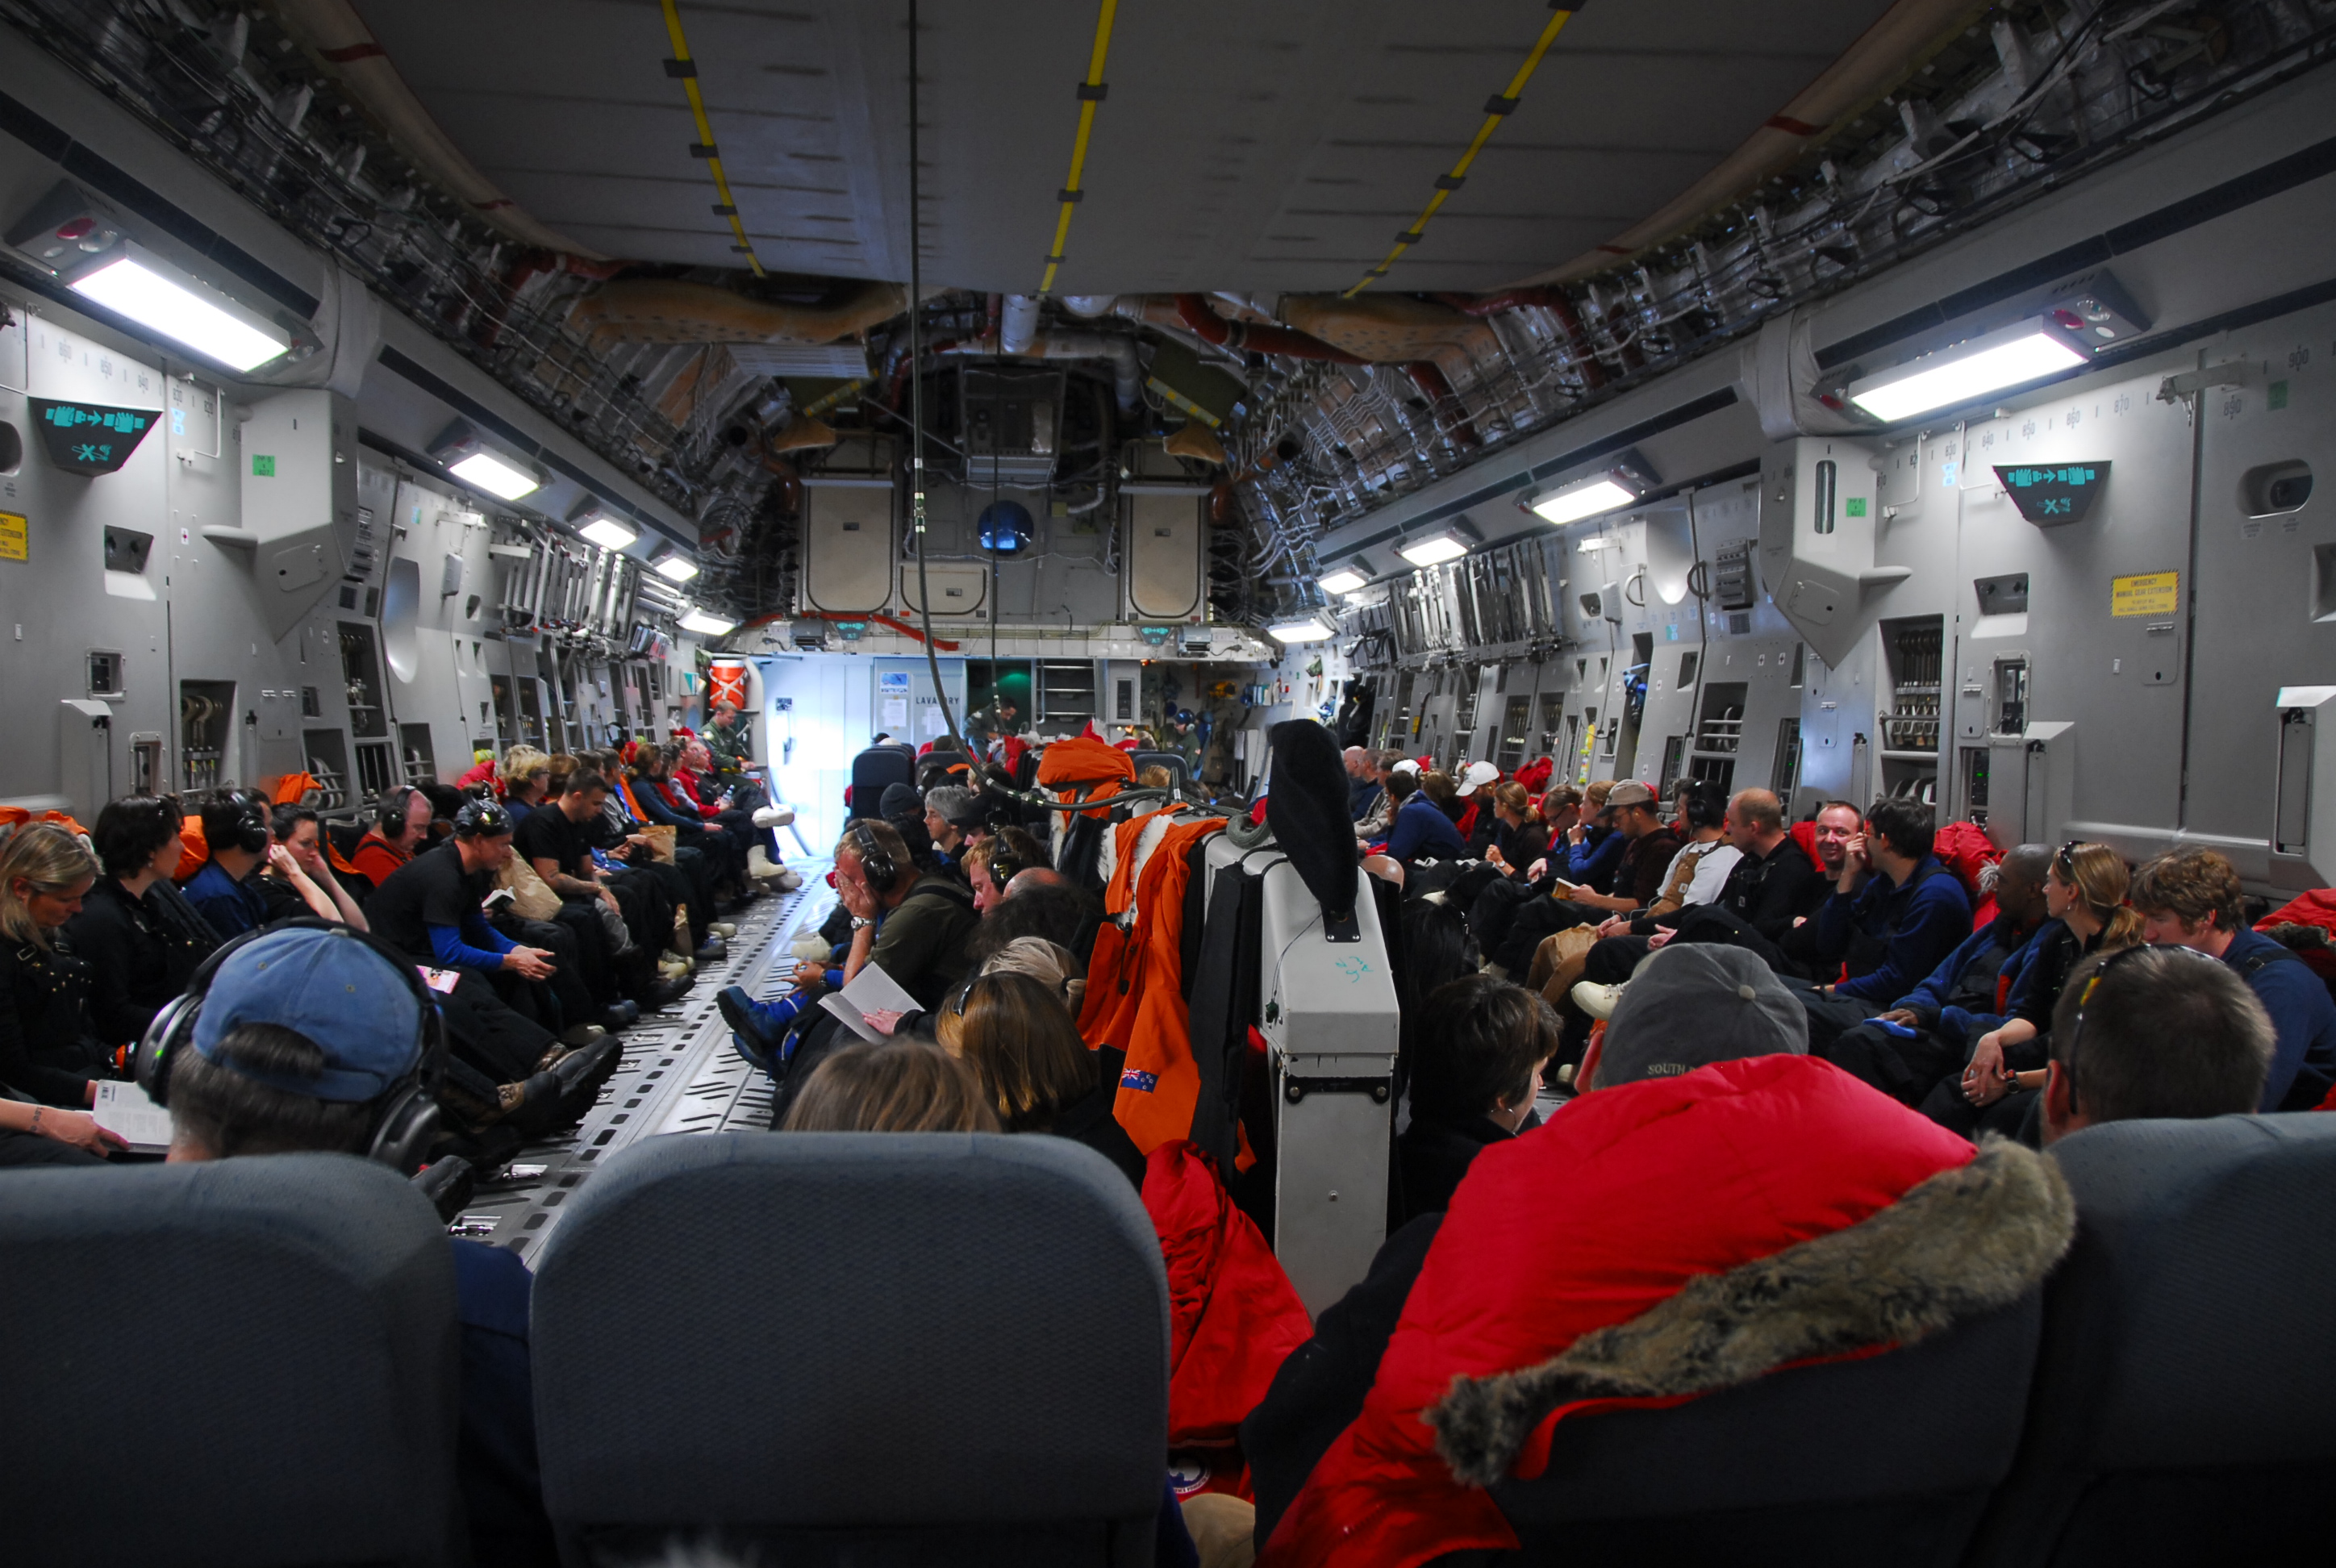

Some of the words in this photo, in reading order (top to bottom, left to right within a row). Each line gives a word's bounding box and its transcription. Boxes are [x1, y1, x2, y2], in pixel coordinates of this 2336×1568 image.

[2288, 348, 2309, 369] 900
[2113, 397, 2130, 413] 870
[2223, 398, 2242, 416] 890
[2066, 410, 2080, 425] 860
[2022, 422, 2036, 436] 850
[1982, 433, 1994, 447] 840
[1945, 444, 1956, 457] 830
[2131, 578, 2157, 586] EMERGENCY
[1648, 1063, 1686, 1075] SOUTH
